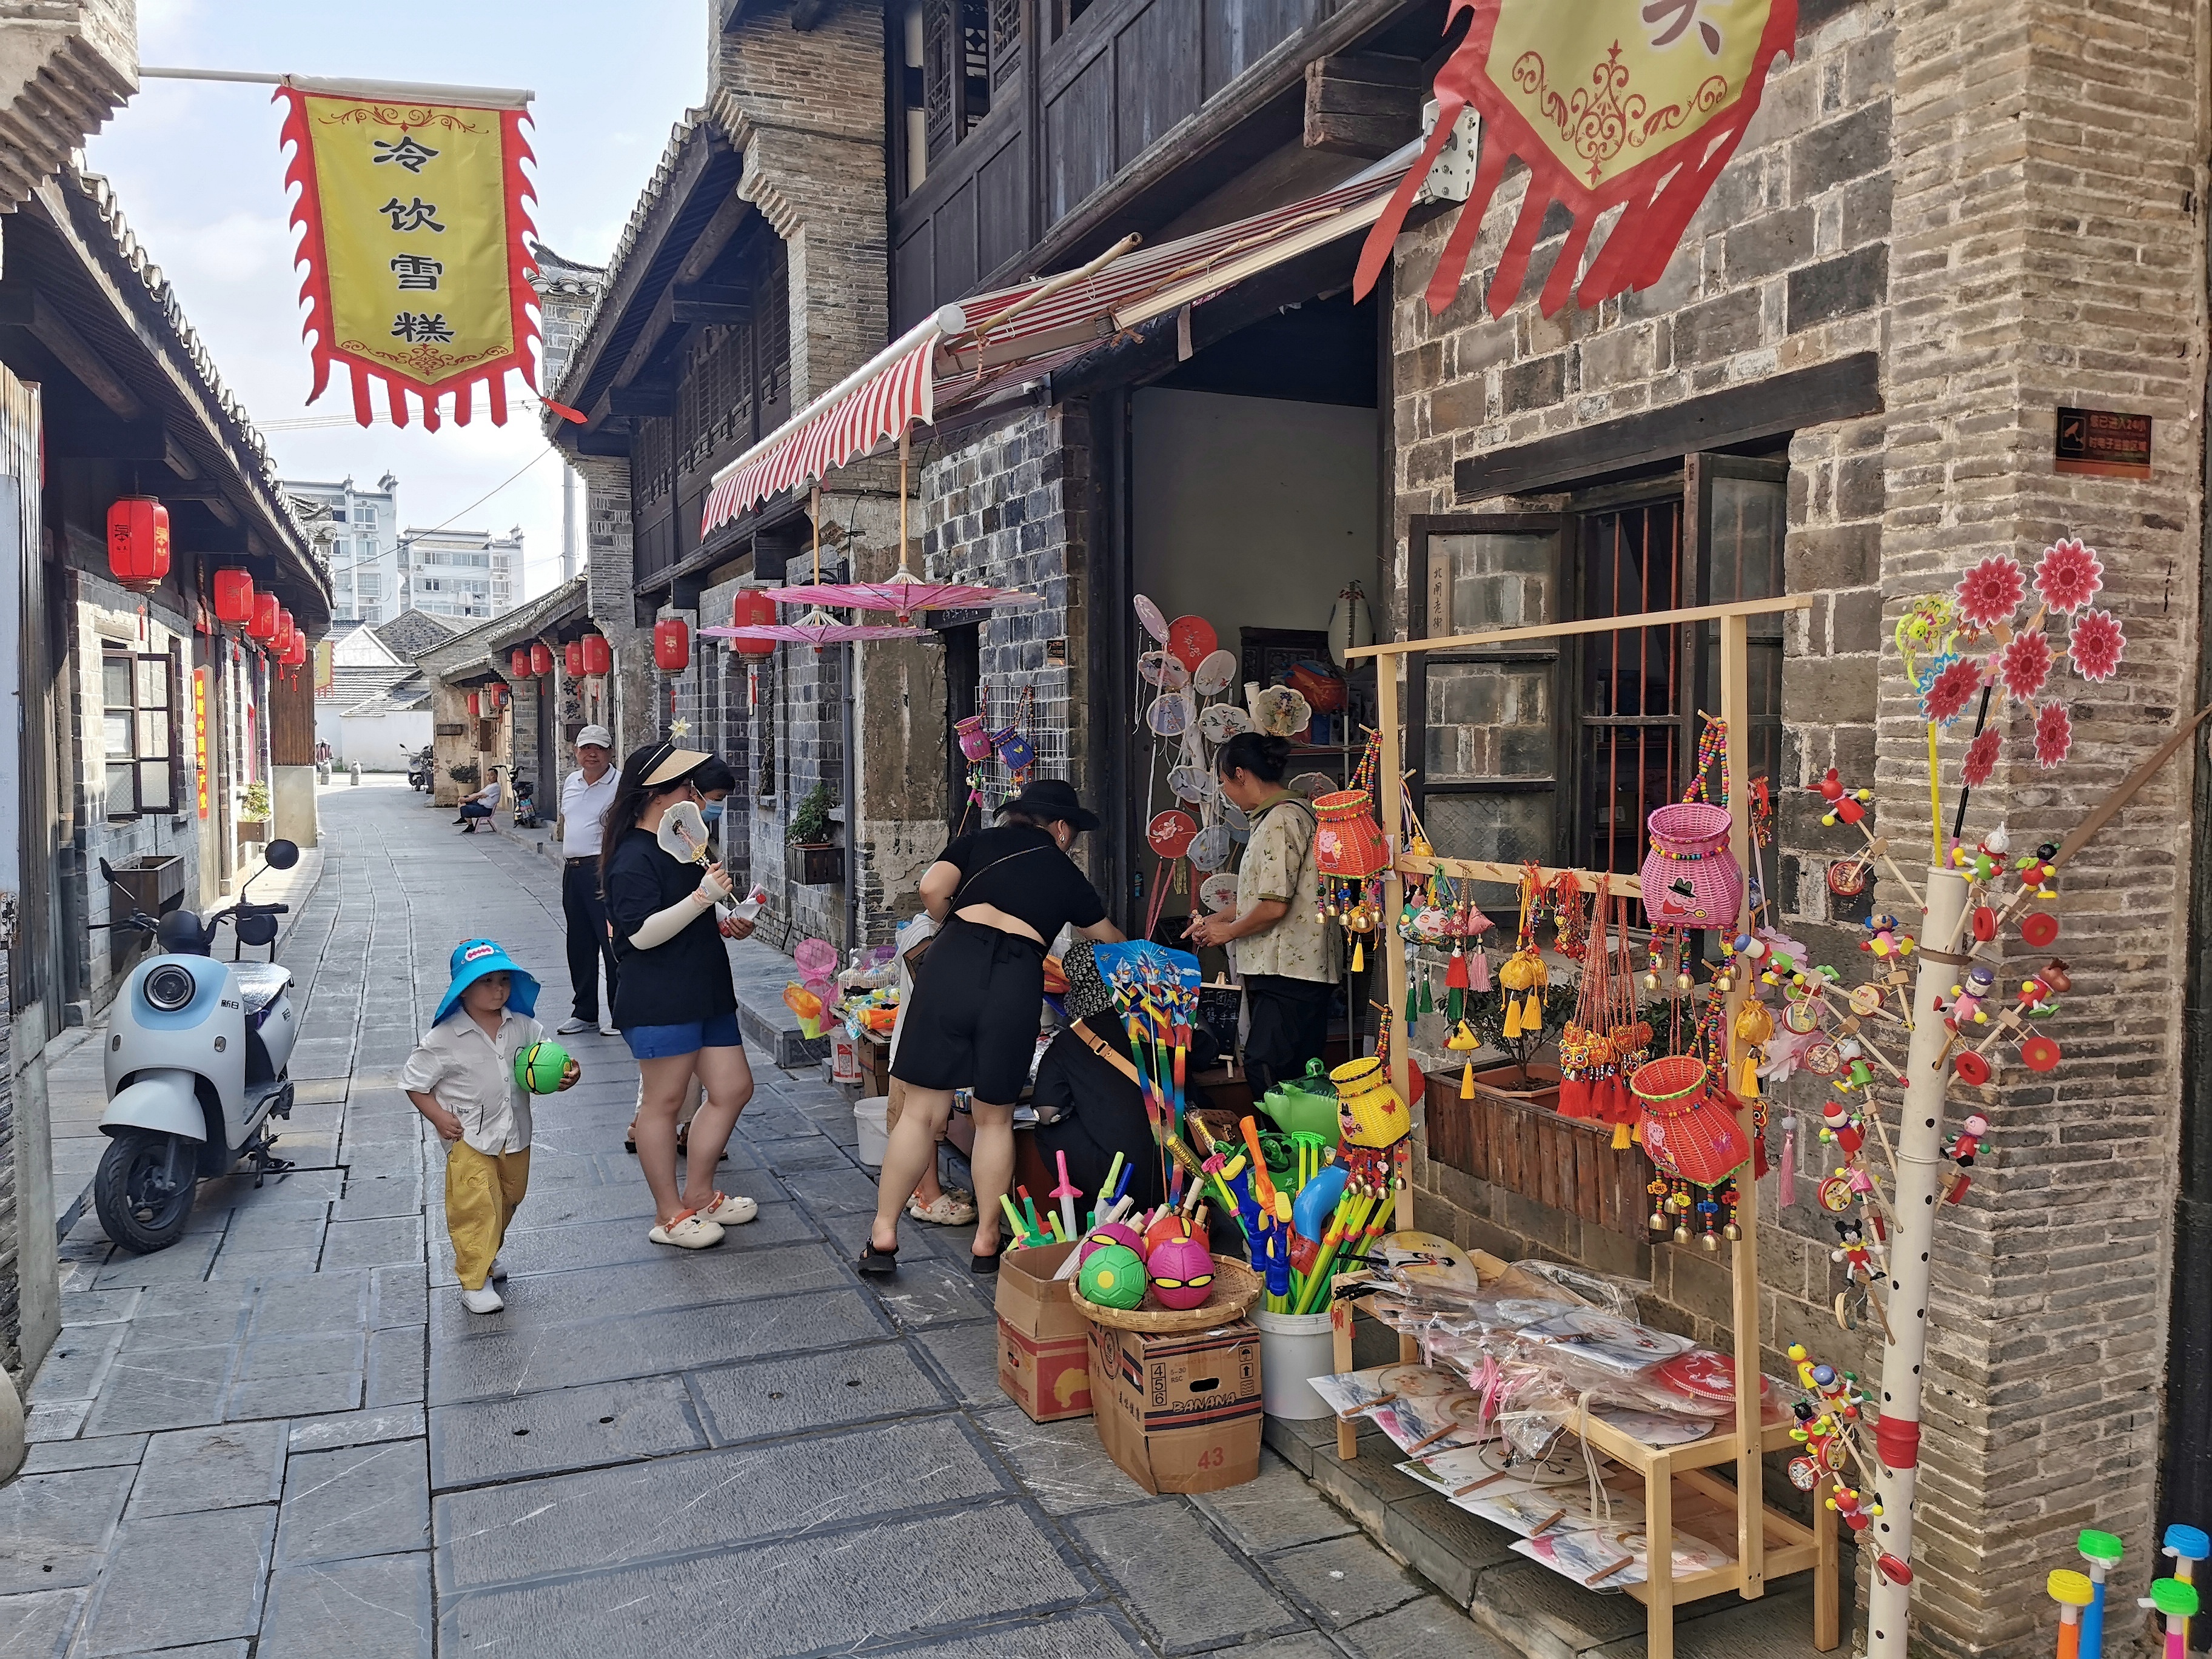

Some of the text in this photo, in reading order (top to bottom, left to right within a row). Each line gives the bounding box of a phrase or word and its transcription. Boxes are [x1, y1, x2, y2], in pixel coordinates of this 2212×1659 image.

[373, 136, 454, 343] 冷饮雪糕
[221, 999, 239, 1010] 新日
[1153, 1365, 1163, 1376] 4
[1155, 1378, 1164, 1390] 5
[1155, 1393, 1164, 1405] 6
[1172, 1392, 1237, 1413] BANANA
[1198, 1446, 1224, 1469] 43
